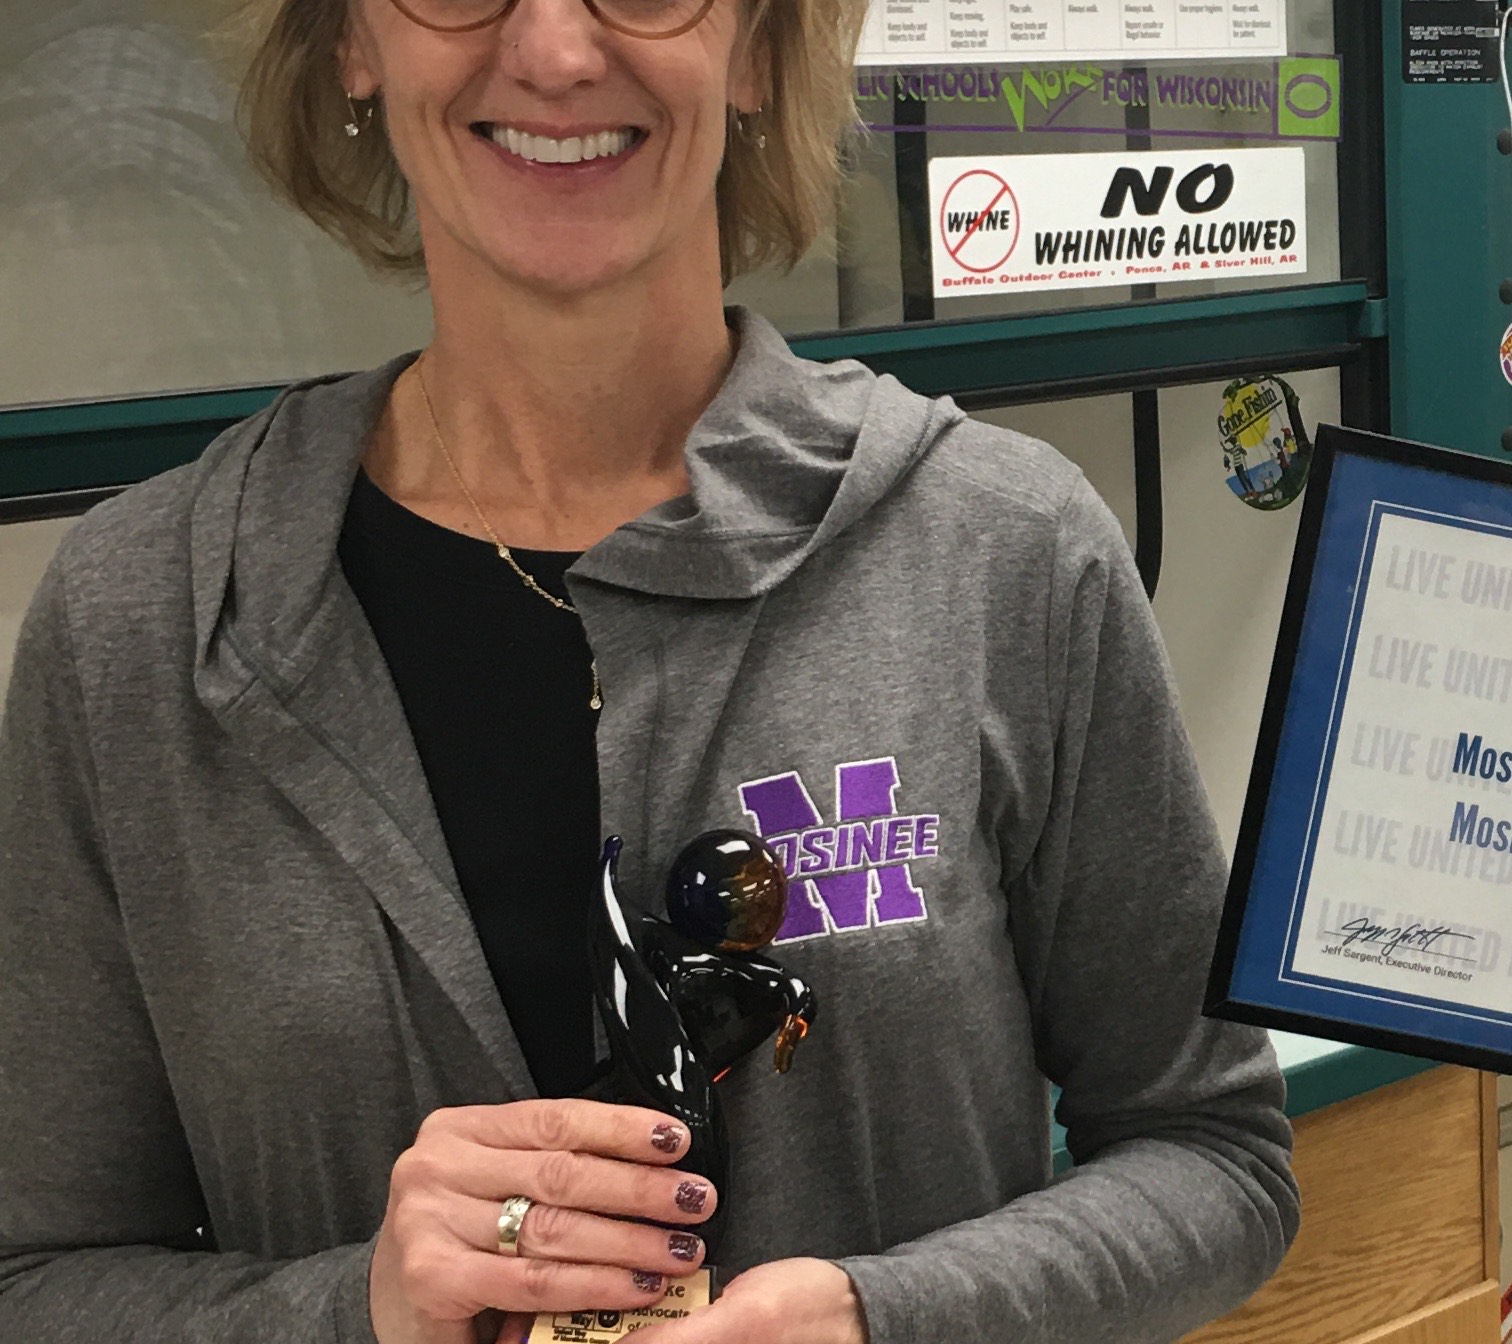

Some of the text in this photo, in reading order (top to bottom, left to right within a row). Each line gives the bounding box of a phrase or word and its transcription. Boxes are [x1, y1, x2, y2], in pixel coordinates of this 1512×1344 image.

[1102, 70, 1148, 107] FOR
[1155, 74, 1271, 113] WISCONSIN
[1100, 162, 1234, 219] NO
[947, 209, 1011, 233] WHINE
[1035, 219, 1297, 266] WHINING ALLOWED
[942, 275, 994, 287] Buffalo
[999, 272, 1053, 284] Outdoor
[1058, 269, 1102, 280] Center
[1172, 261, 1191, 271] AR
[1279, 254, 1298, 263] AR
[1385, 544, 1456, 599] LIVE
[1368, 634, 1439, 689] LIVE
[1350, 721, 1421, 777] LIVE
[766, 813, 940, 880] OSINEE
[1333, 809, 1404, 866] LIVE
[1321, 944, 1343, 956] Jeff
[1386, 956, 1431, 974] Executive
[1434, 965, 1474, 982] Director
